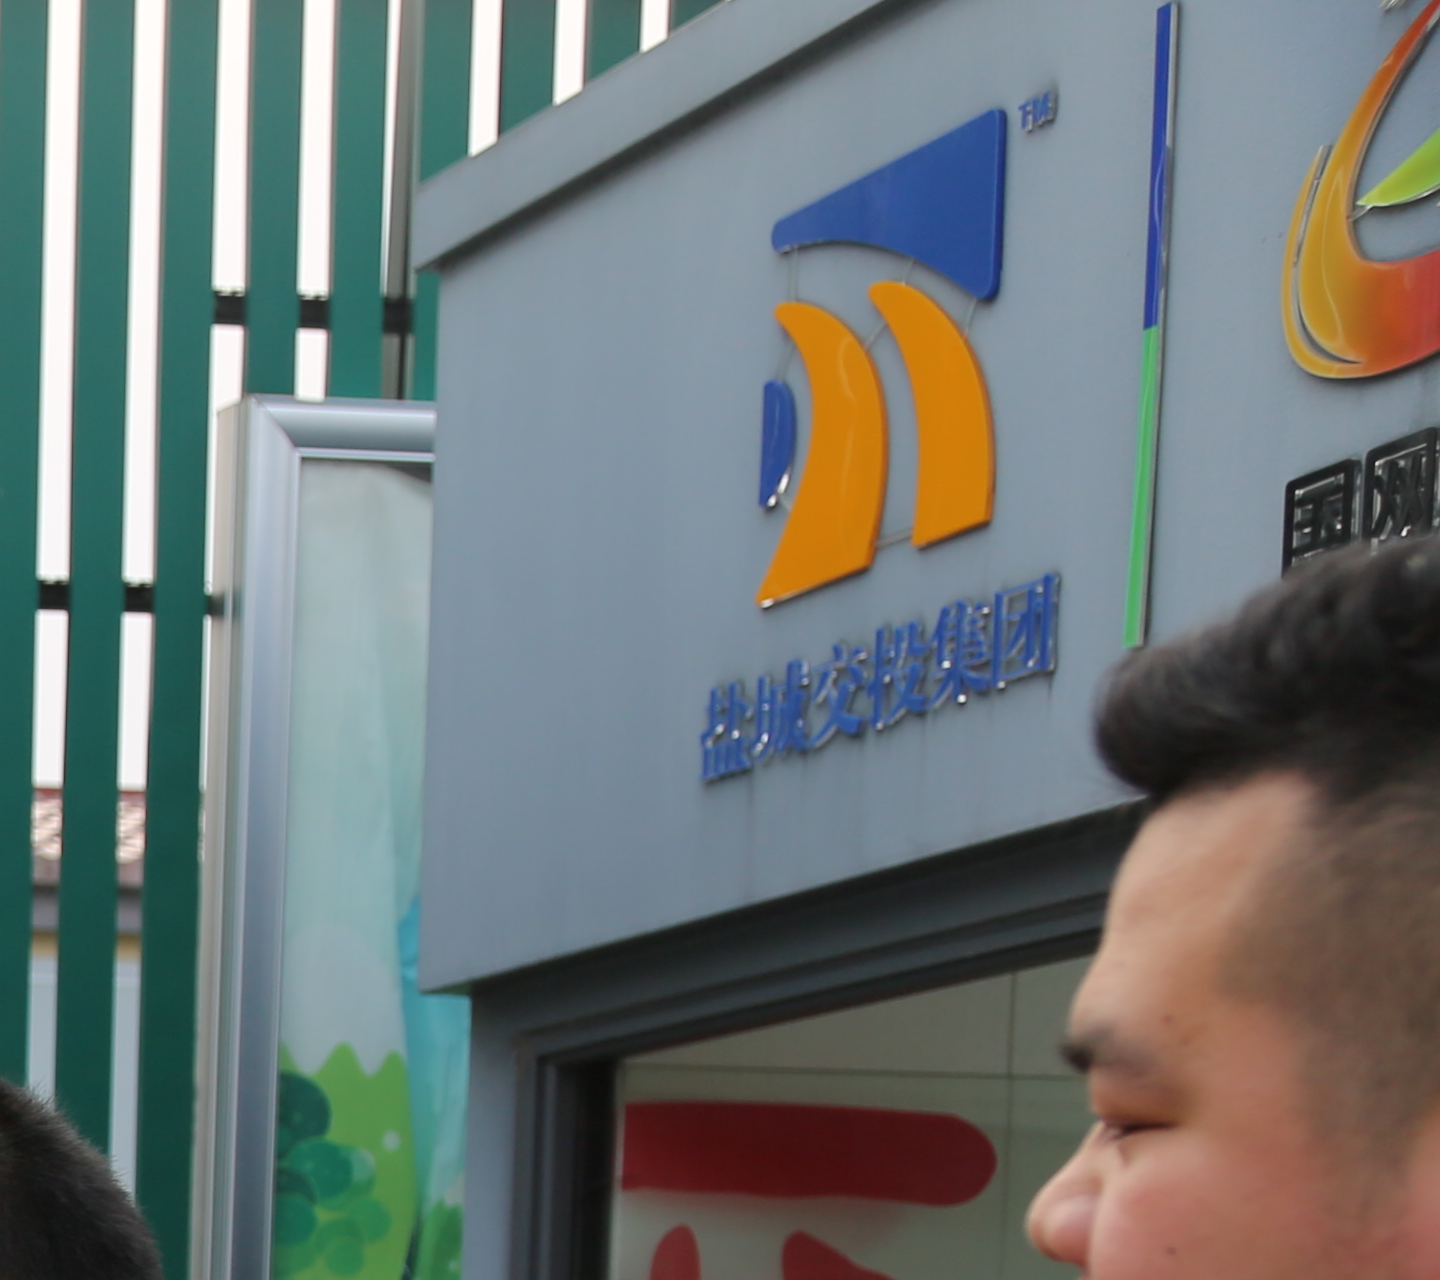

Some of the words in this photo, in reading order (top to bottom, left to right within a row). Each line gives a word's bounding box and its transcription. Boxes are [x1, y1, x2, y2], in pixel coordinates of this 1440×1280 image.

[700, 571, 1061, 783] 盐城交投集团
